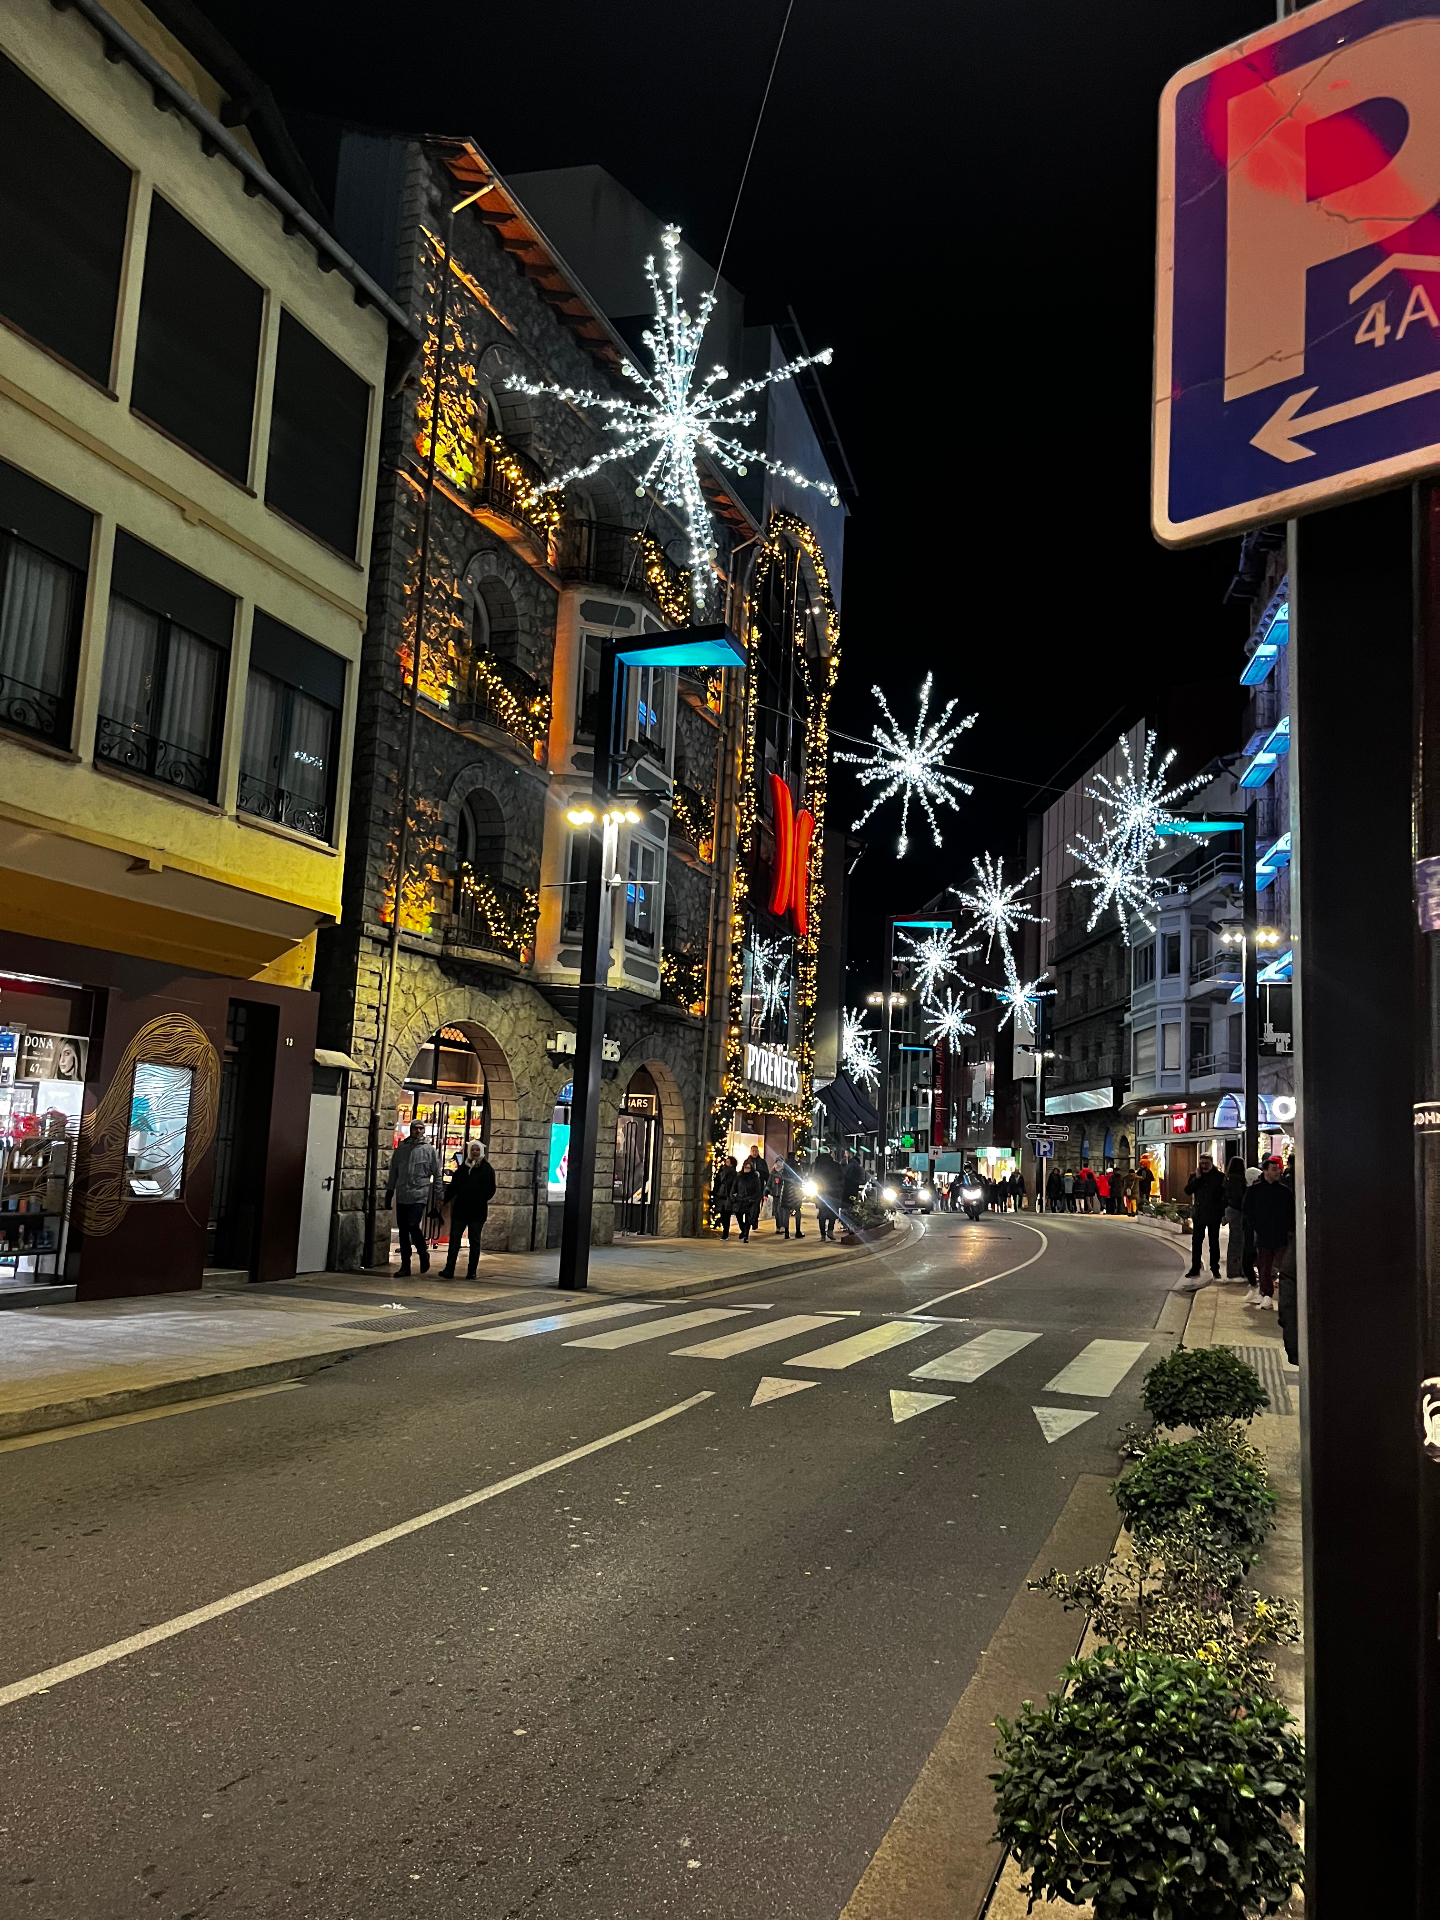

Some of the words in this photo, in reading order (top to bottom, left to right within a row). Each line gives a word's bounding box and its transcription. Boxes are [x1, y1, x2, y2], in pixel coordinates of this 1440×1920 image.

[1224, 17, 1440, 402] P
[24, 1035, 53, 1050] DONA
[1039, 1140, 1050, 1155] P
